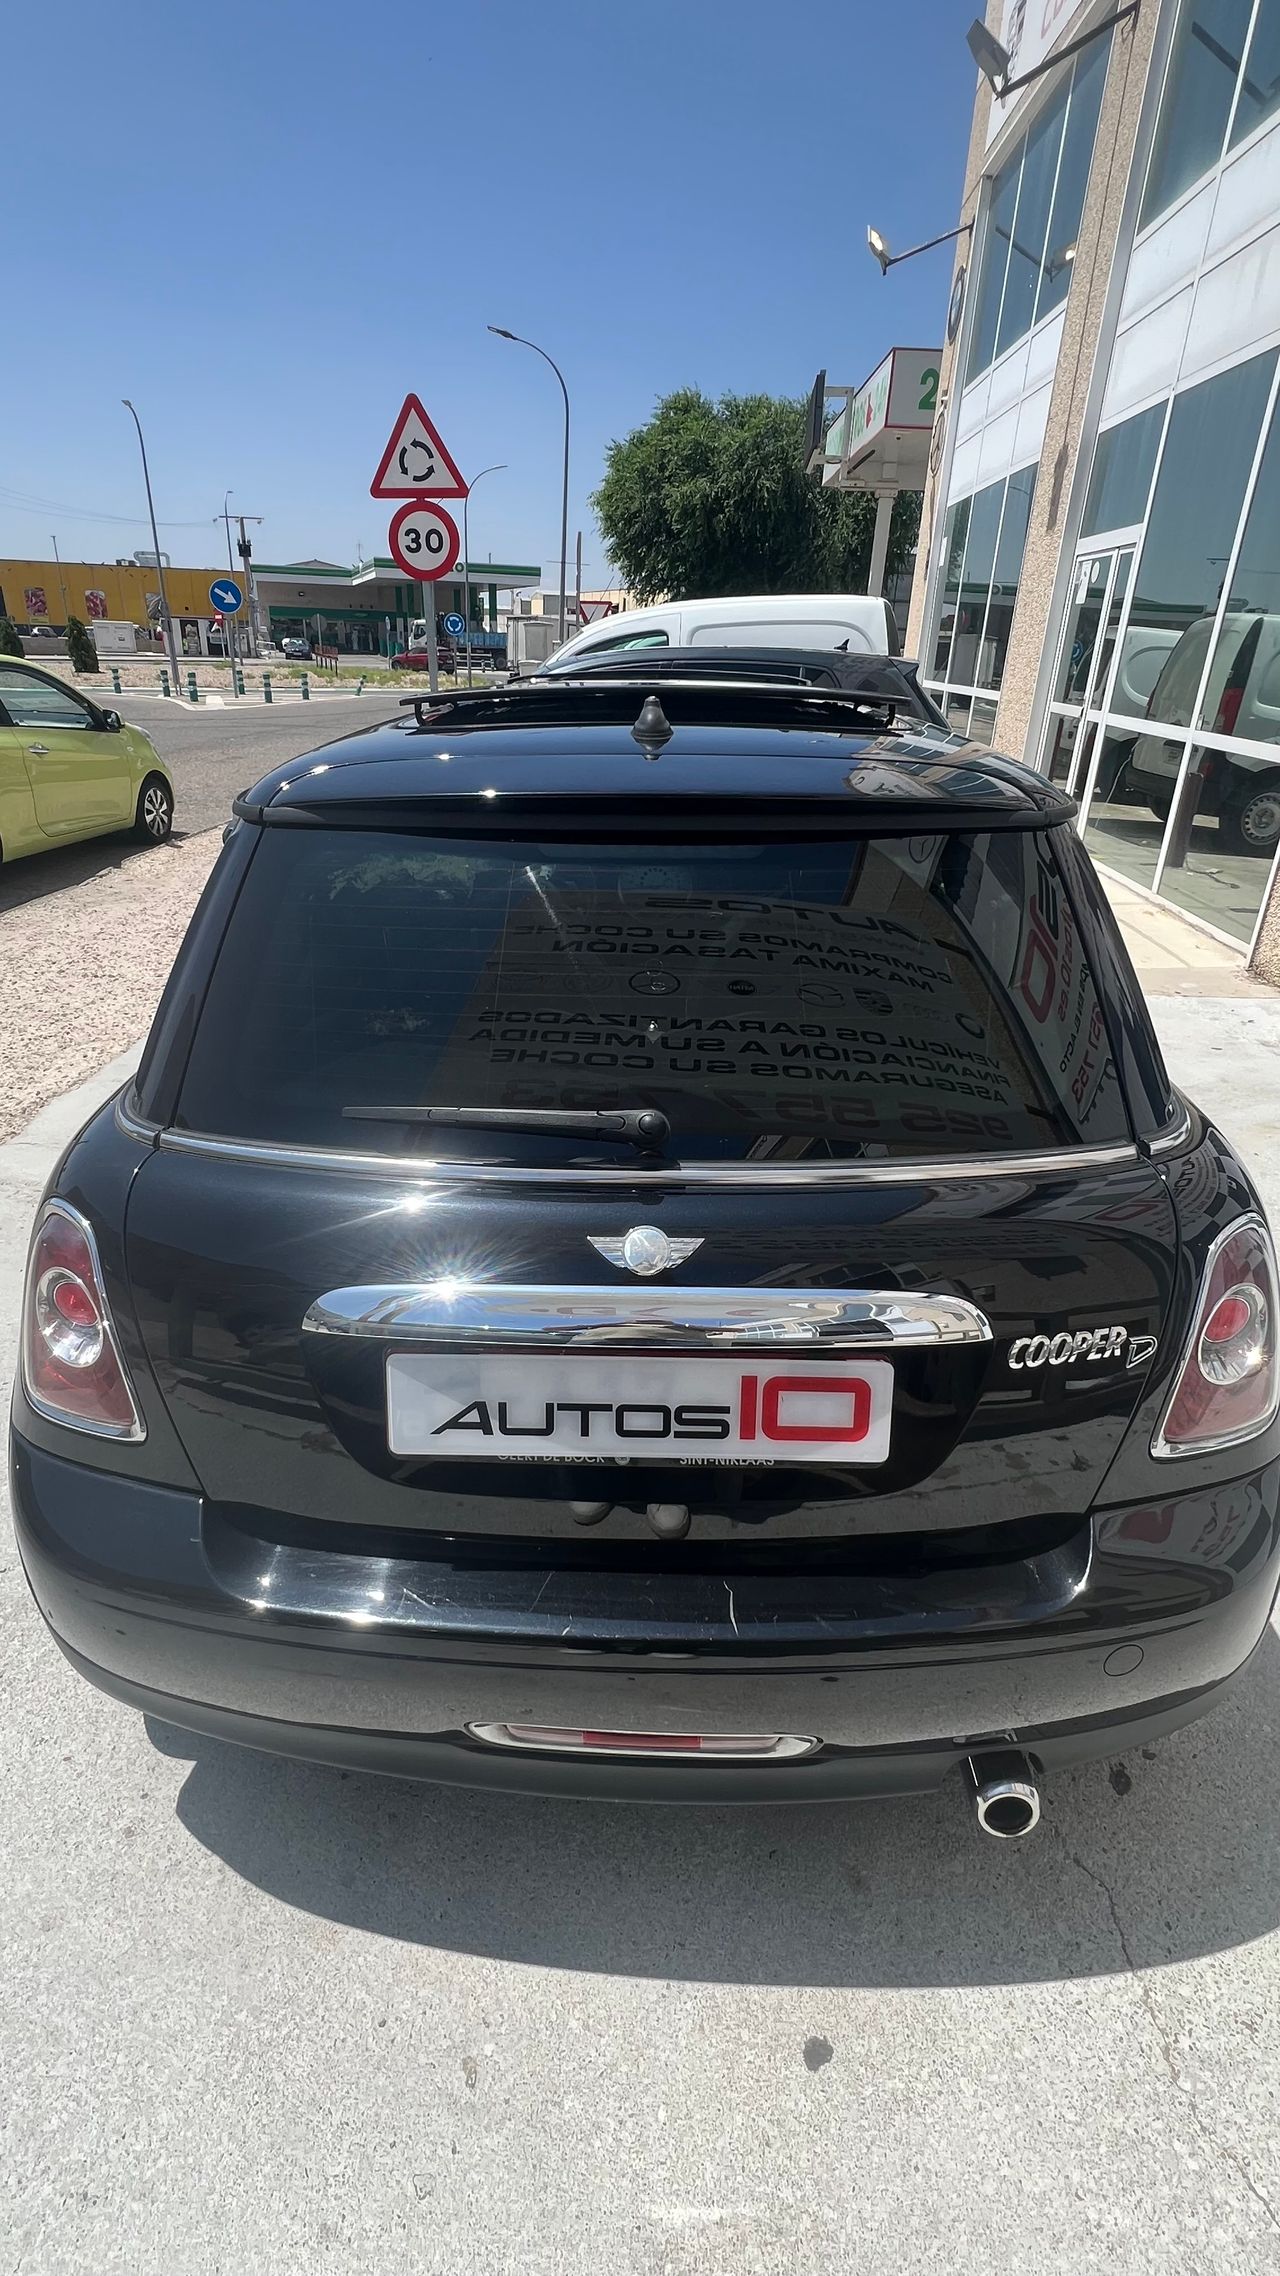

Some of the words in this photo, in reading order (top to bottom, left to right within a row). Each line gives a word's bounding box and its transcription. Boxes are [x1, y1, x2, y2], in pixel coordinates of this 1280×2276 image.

[404, 527, 444, 554] 30
[1007, 1325, 1128, 1370] COOPER
[1126, 1335, 1158, 1369] D
